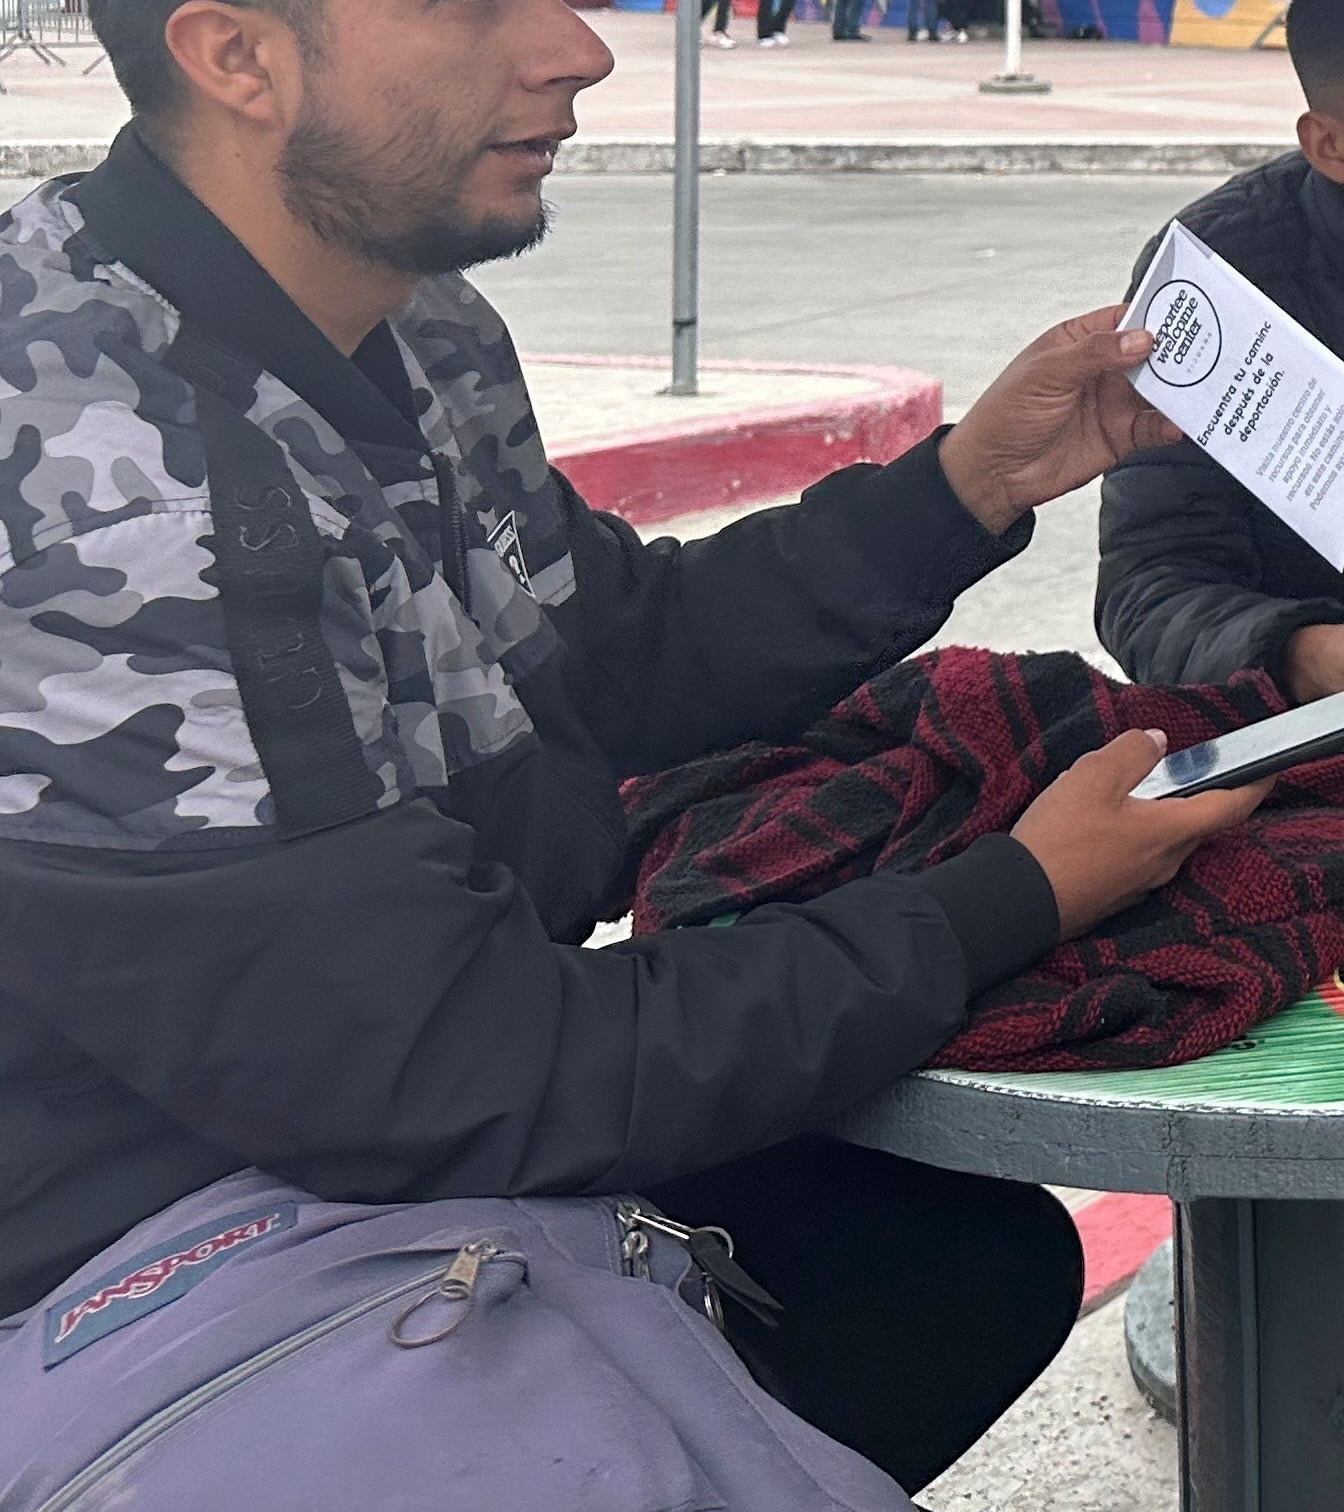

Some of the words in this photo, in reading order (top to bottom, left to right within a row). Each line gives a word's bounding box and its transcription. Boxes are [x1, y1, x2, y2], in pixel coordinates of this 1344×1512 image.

[1157, 298, 1198, 363] welcome
[1174, 317, 1202, 364] center
[1197, 384, 1237, 446] Encuentra
[1234, 368, 1246, 382] tu
[1224, 388, 1255, 435] después
[1252, 369, 1265, 384] de
[1261, 353, 1274, 366] la
[1239, 370, 1285, 442] deportación.
[1292, 423, 1307, 445] para
[1283, 456, 1301, 483] apoyo
[1305, 483, 1315, 497] en
[1312, 463, 1327, 484] este
[54, 1213, 280, 1343] JANSPORT
